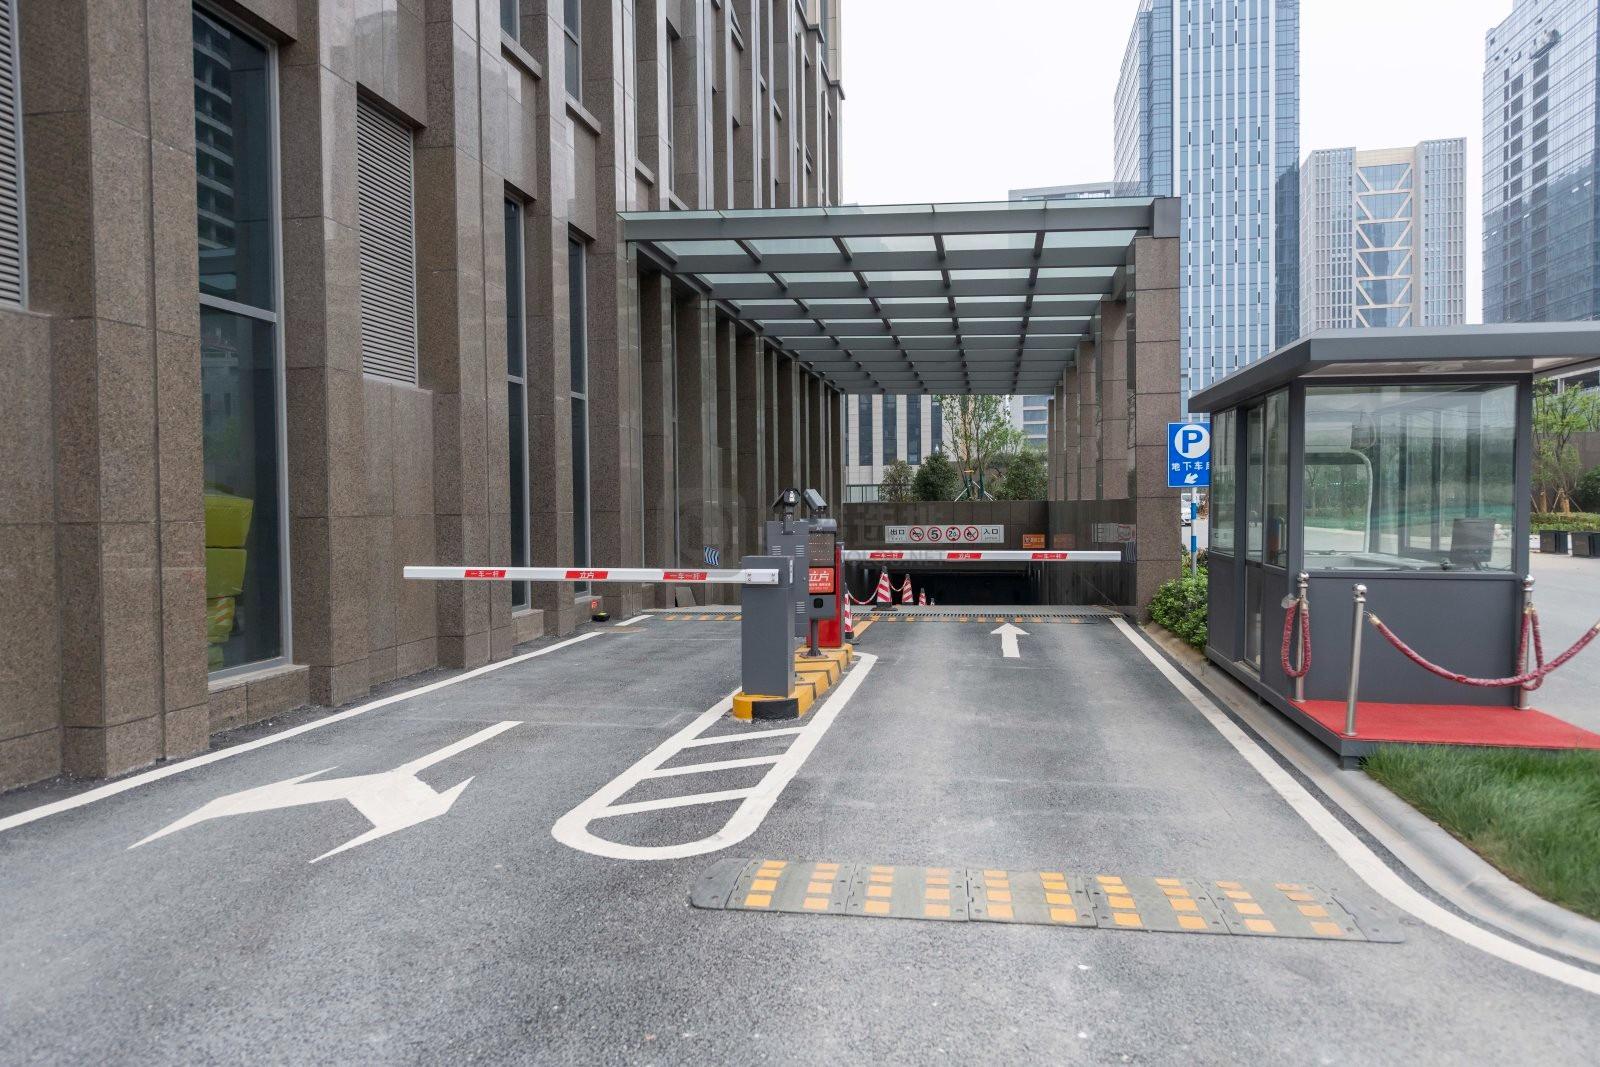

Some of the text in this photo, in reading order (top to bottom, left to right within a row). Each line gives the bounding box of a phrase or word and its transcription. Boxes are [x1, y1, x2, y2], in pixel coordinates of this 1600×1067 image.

[1182, 429, 1203, 453] P
[890, 528, 905, 536] 出口
[931, 529, 939, 540] 5
[470, 570, 499, 578] 一车一杆
